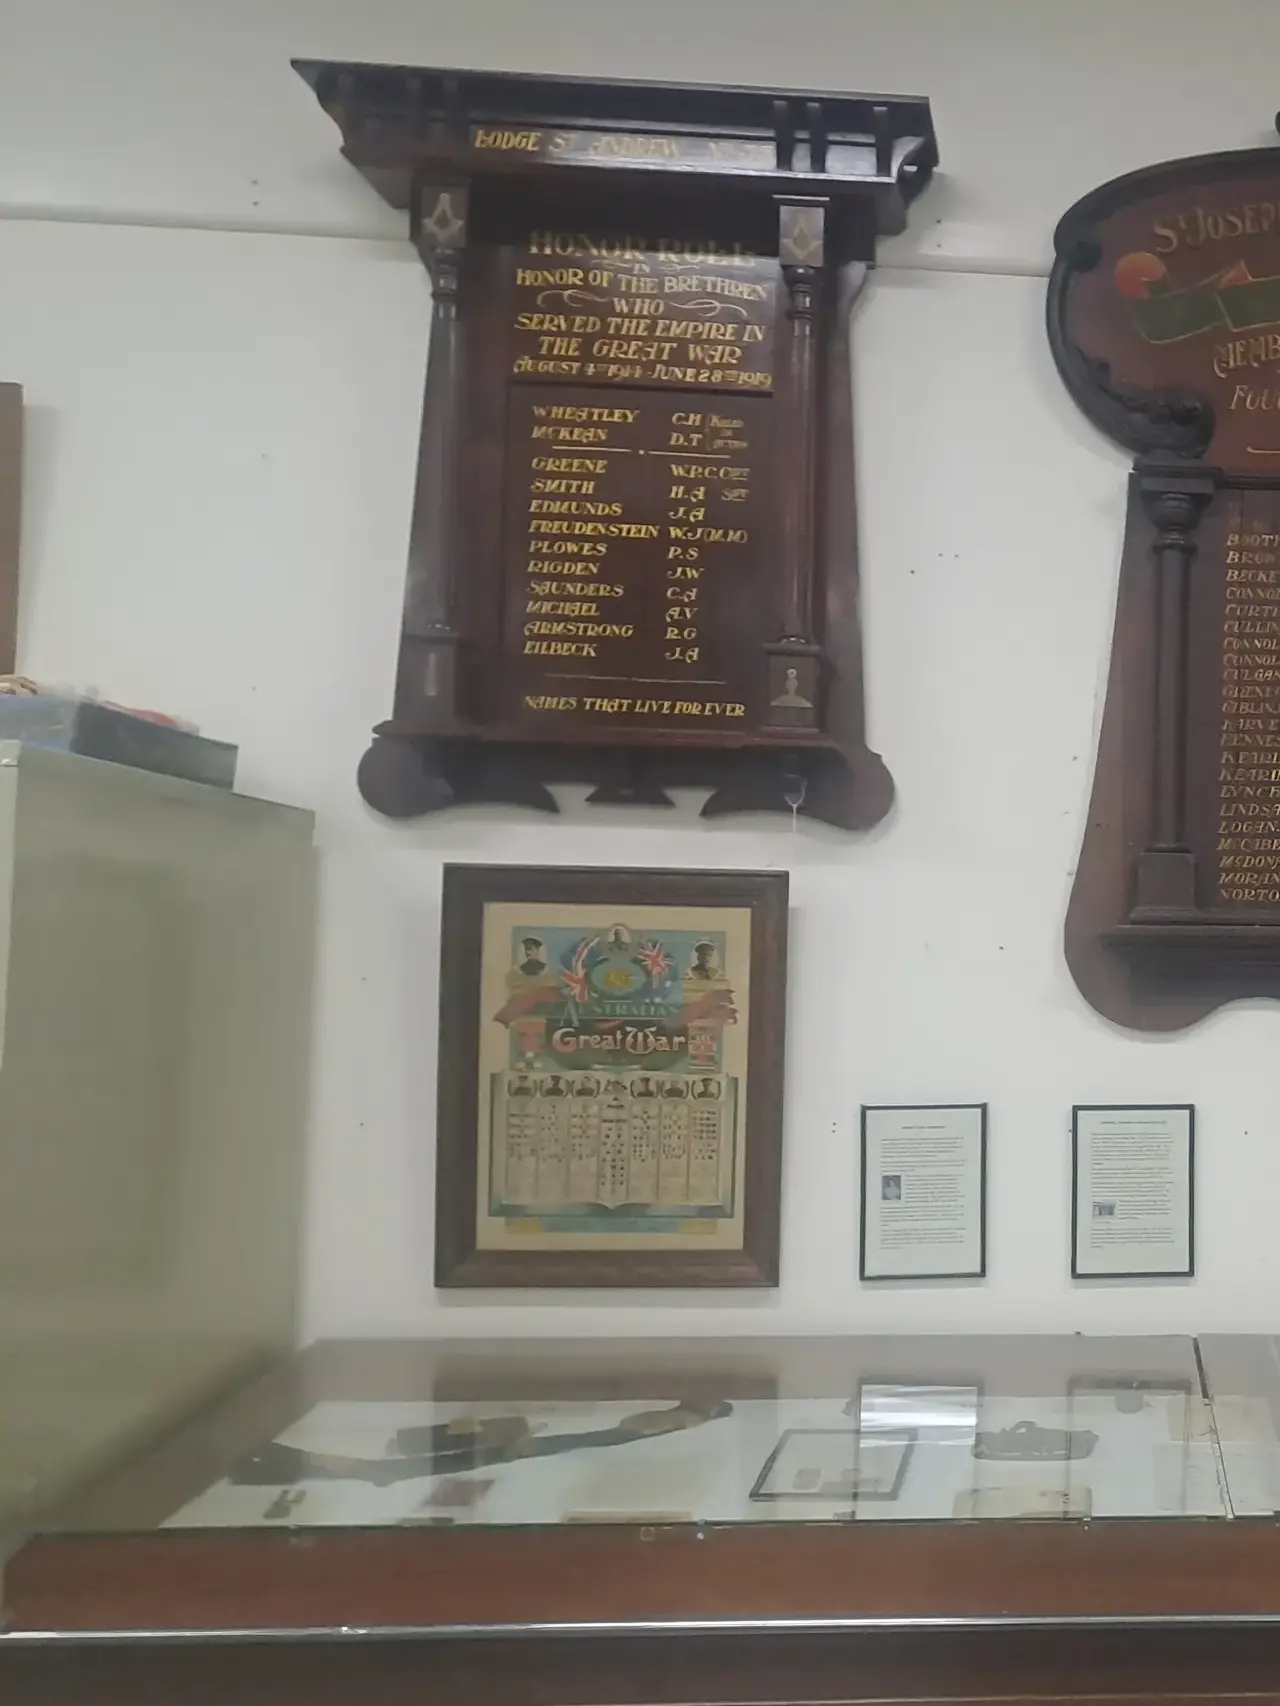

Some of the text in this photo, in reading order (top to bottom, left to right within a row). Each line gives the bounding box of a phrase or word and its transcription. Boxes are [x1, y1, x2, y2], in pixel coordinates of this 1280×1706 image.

[474, 129, 540, 151] LODGE
[516, 267, 768, 301] HONOR OF THE BRETHREN
[612, 297, 664, 316] WHO
[514, 313, 768, 343] SERVED THE EMPIRE IN
[538, 336, 743, 365] THE GREAT WAR
[513, 355, 582, 376] AUGUST
[532, 405, 641, 424] WHEATLEY
[531, 457, 608, 474] GREENE
[529, 478, 596, 495] SMITH
[528, 499, 624, 516] EDMUNDS
[528, 519, 660, 539] FREUDENSTEIN
[528, 540, 608, 556] PLOWES
[526, 560, 600, 576] RIGDEN
[526, 579, 625, 598] SAUNDERS
[525, 600, 600, 617] MICHAEL
[523, 620, 635, 637] ARMSTRONG
[522, 640, 599, 658] EILBECK
[525, 696, 577, 710] NAMES
[583, 697, 632, 713] THAT
[634, 699, 672, 714] LIVE
[552, 1026, 686, 1055] Great War
